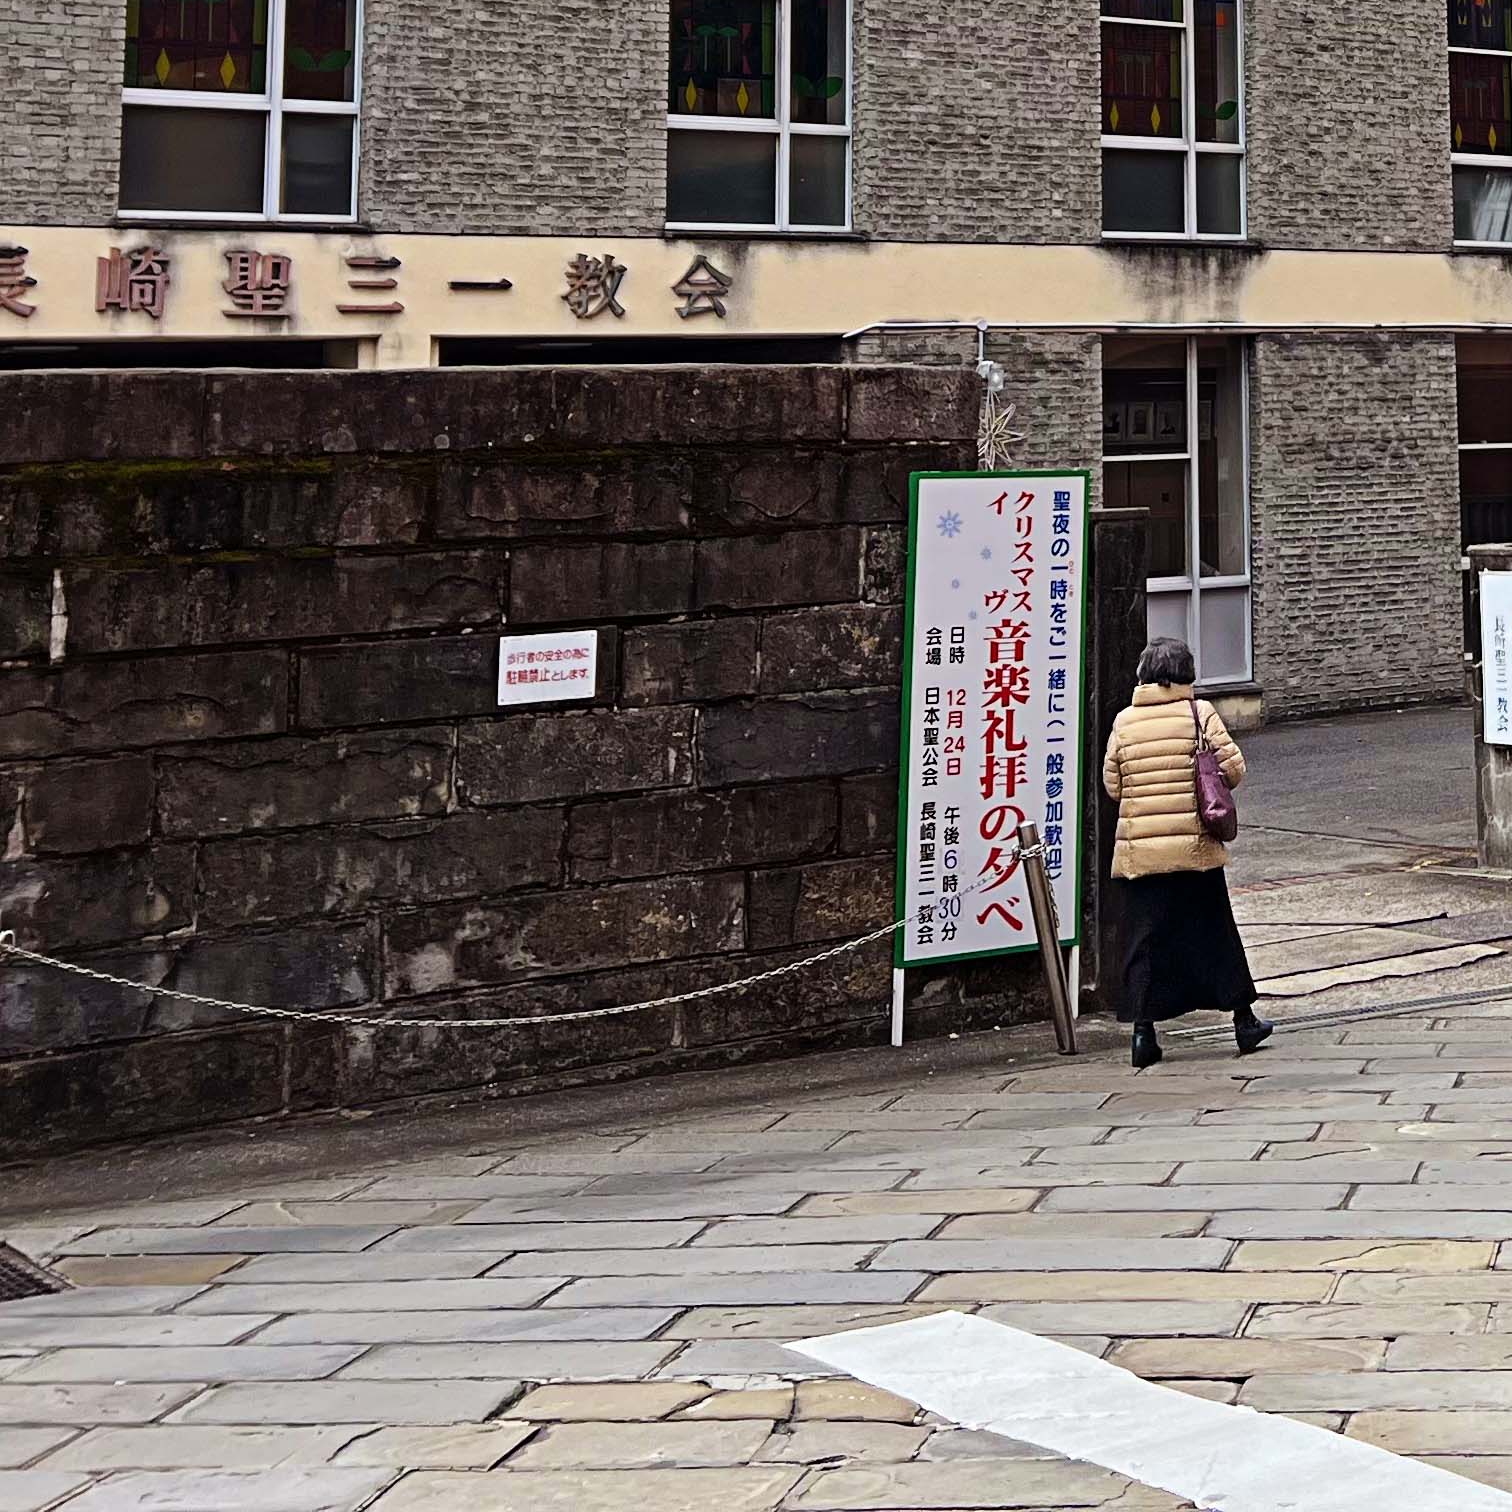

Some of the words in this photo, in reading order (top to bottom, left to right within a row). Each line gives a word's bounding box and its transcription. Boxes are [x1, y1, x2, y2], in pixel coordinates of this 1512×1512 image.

[0, 245, 733, 320] 長崎聖三一教会
[1010, 491, 1035, 612] クリスマス
[925, 627, 942, 666] 会場
[949, 626, 965, 664] 日時
[921, 687, 940, 787] 日本聖公会
[943, 688, 966, 776] 12月24日
[916, 801, 936, 945] 長崎聖三一教会
